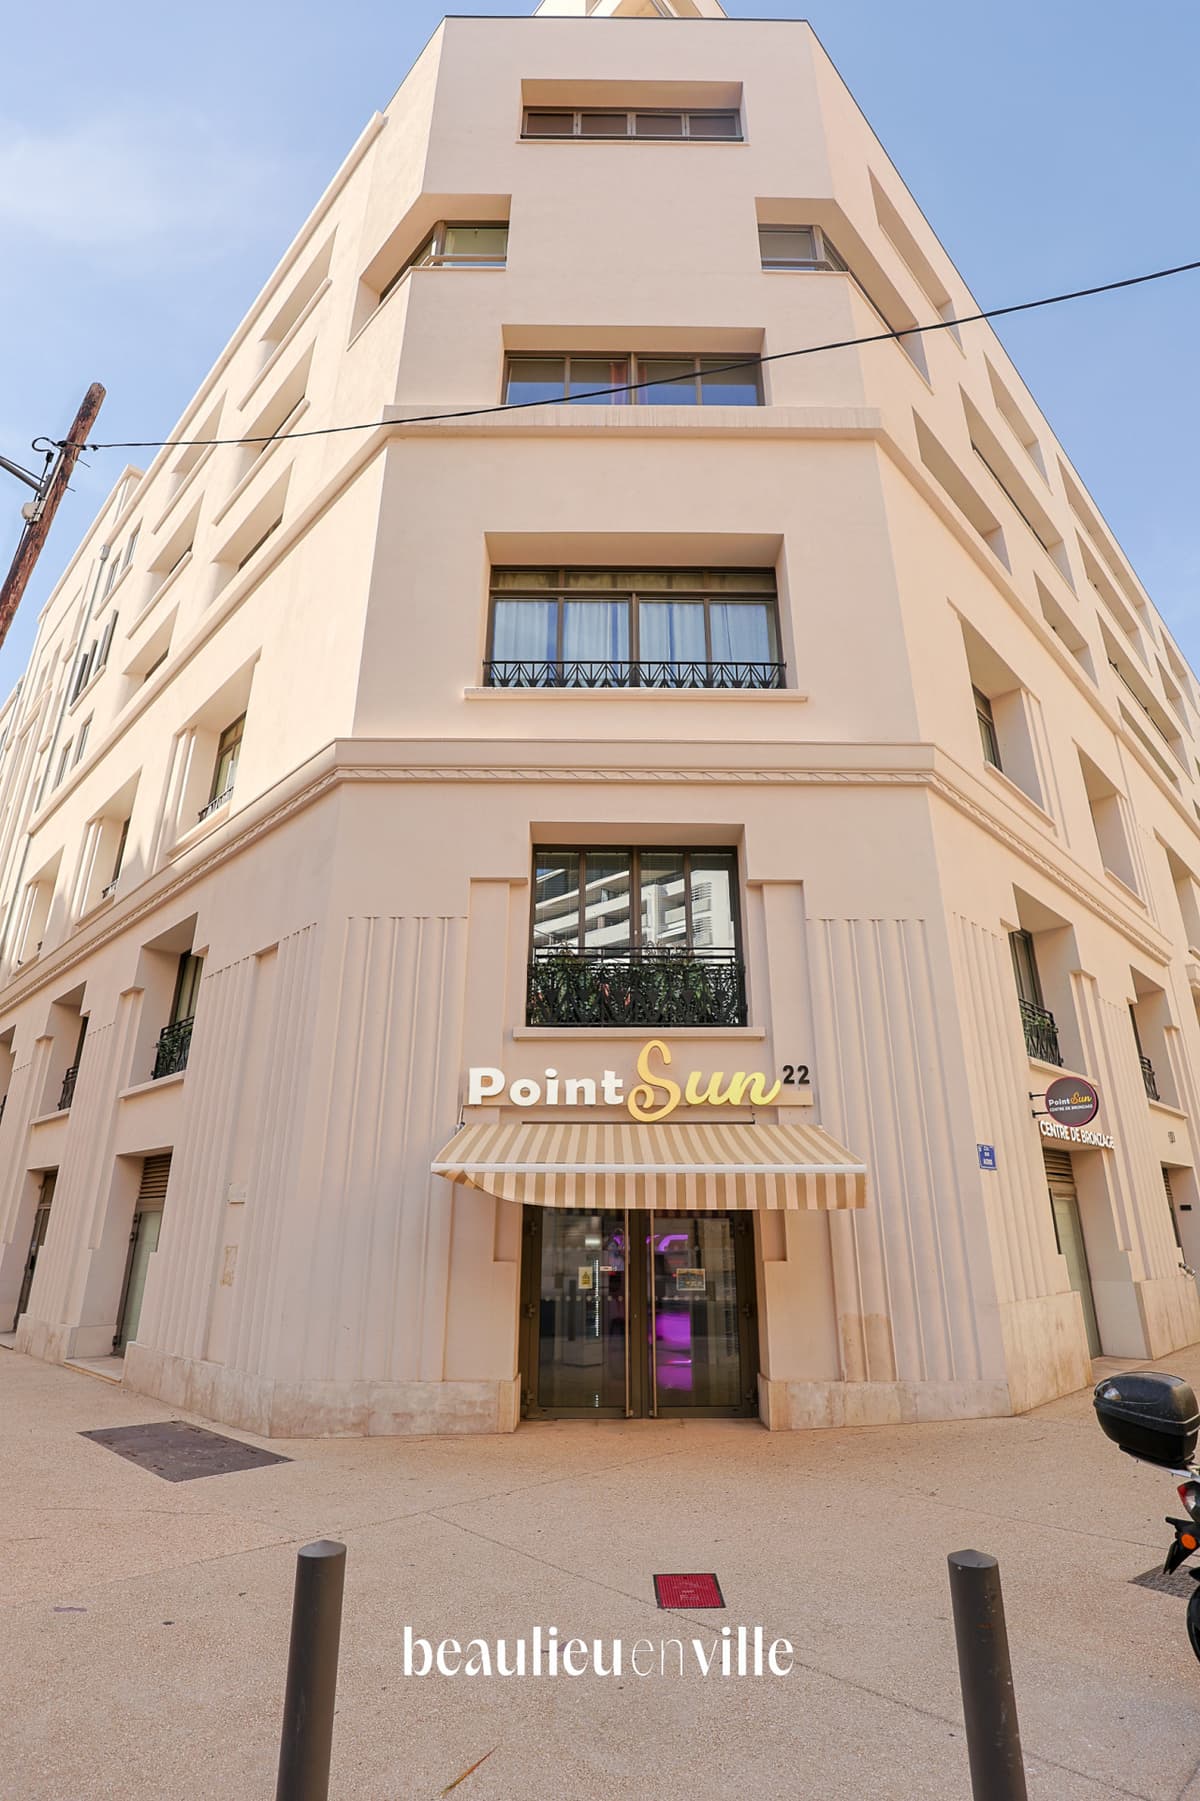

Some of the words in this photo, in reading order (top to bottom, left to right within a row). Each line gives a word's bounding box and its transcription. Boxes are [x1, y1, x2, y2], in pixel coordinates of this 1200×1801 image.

[468, 1067, 624, 1106] Point
[627, 1039, 781, 1122] Sun
[782, 1064, 811, 1085] 22
[1048, 1097, 1070, 1106] Point
[1071, 1091, 1092, 1104] Sun
[1040, 1120, 1070, 1140] CENTRE
[1070, 1127, 1081, 1142] DE
[1081, 1130, 1115, 1148] BRONZAGE
